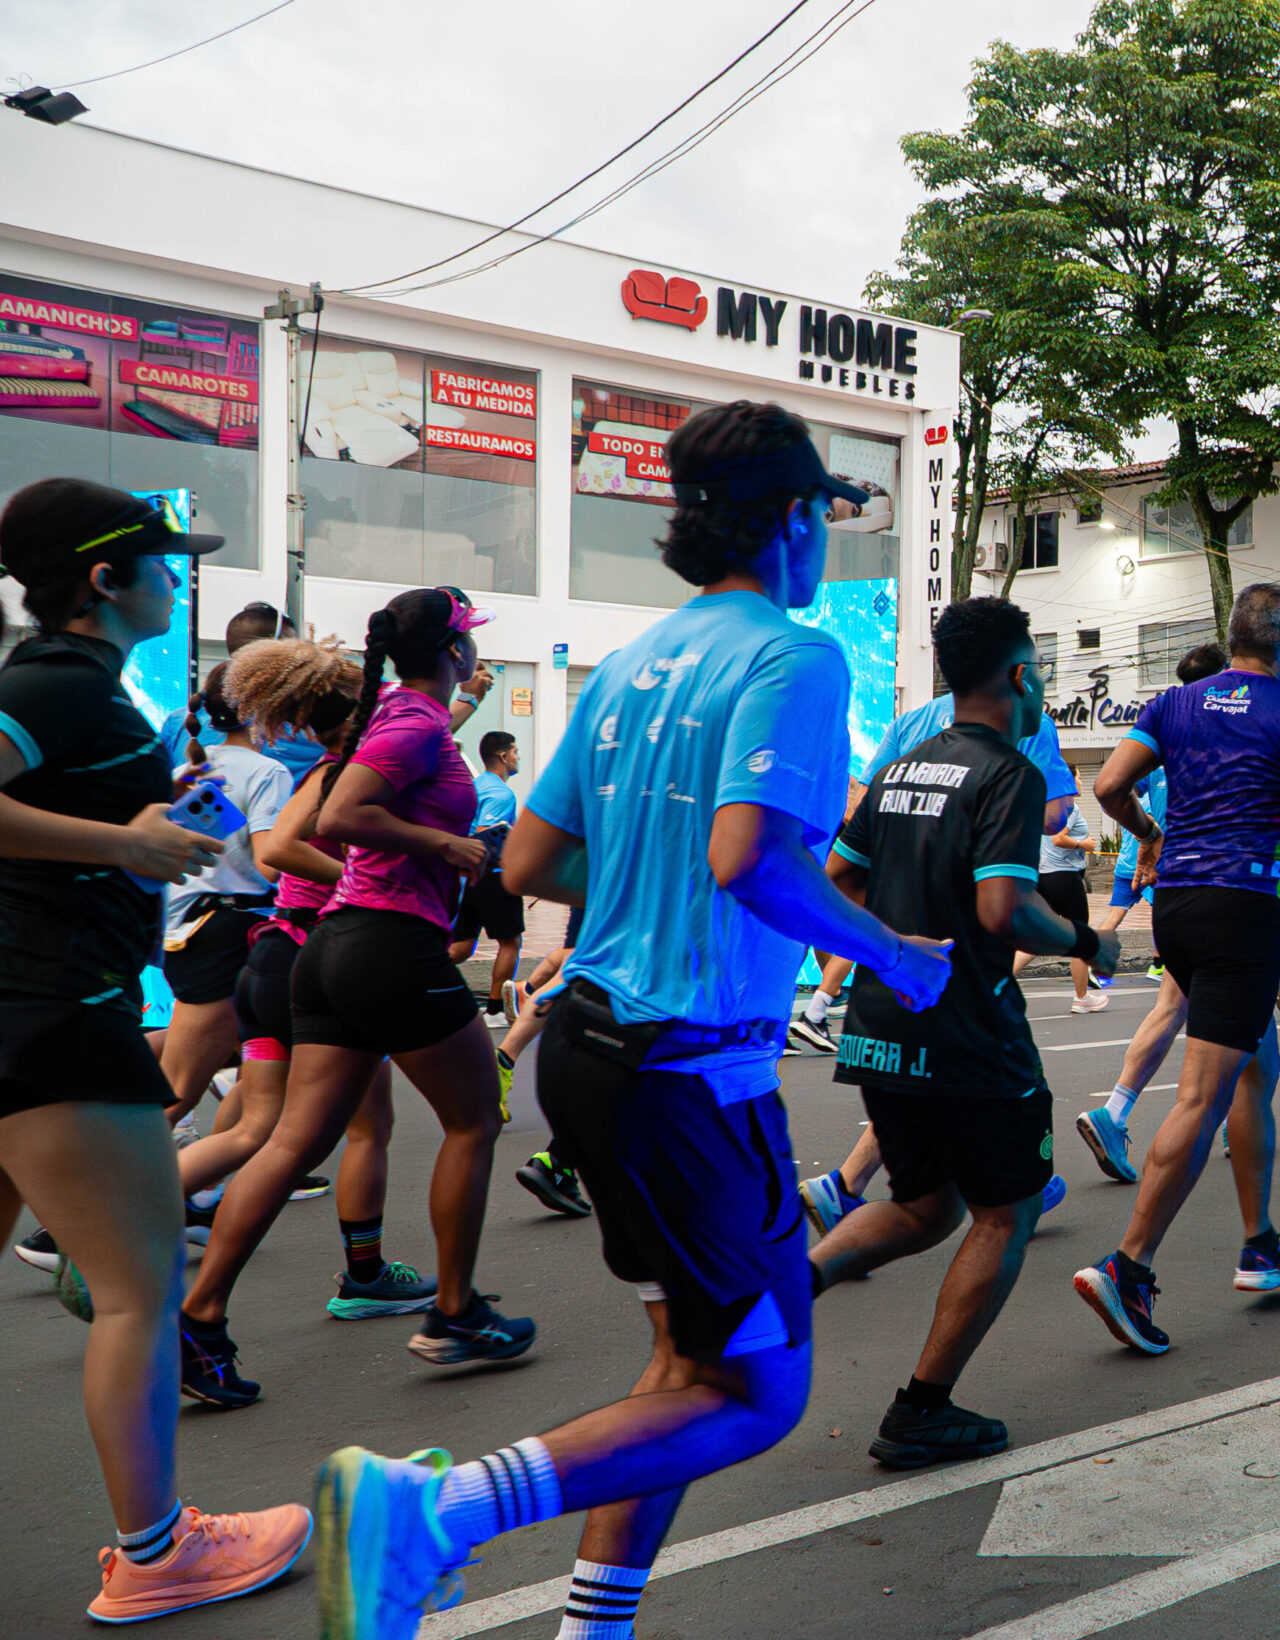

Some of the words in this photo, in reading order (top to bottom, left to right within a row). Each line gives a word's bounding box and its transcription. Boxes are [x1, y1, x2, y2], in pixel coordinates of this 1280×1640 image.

[717, 286, 788, 347] MY
[800, 304, 917, 375] HOME
[136, 366, 249, 398] CAMAROTES
[438, 372, 534, 400] FABRICAMOS
[799, 359, 915, 400] MUEBLES
[436, 388, 448, 402] A
[452, 390, 471, 406] TU
[475, 394, 534, 416] MEDIDA
[427, 428, 533, 456] RESTAURAMOS
[602, 437, 644, 455] TODO
[928, 458, 943, 509] MY
[927, 519, 942, 633] HOME
[1203, 701, 1248, 715] Carvajal
[1206, 694, 1252, 705] Ciudadanos
[878, 789, 914, 815] RUN
[910, 1047, 933, 1078] J.
